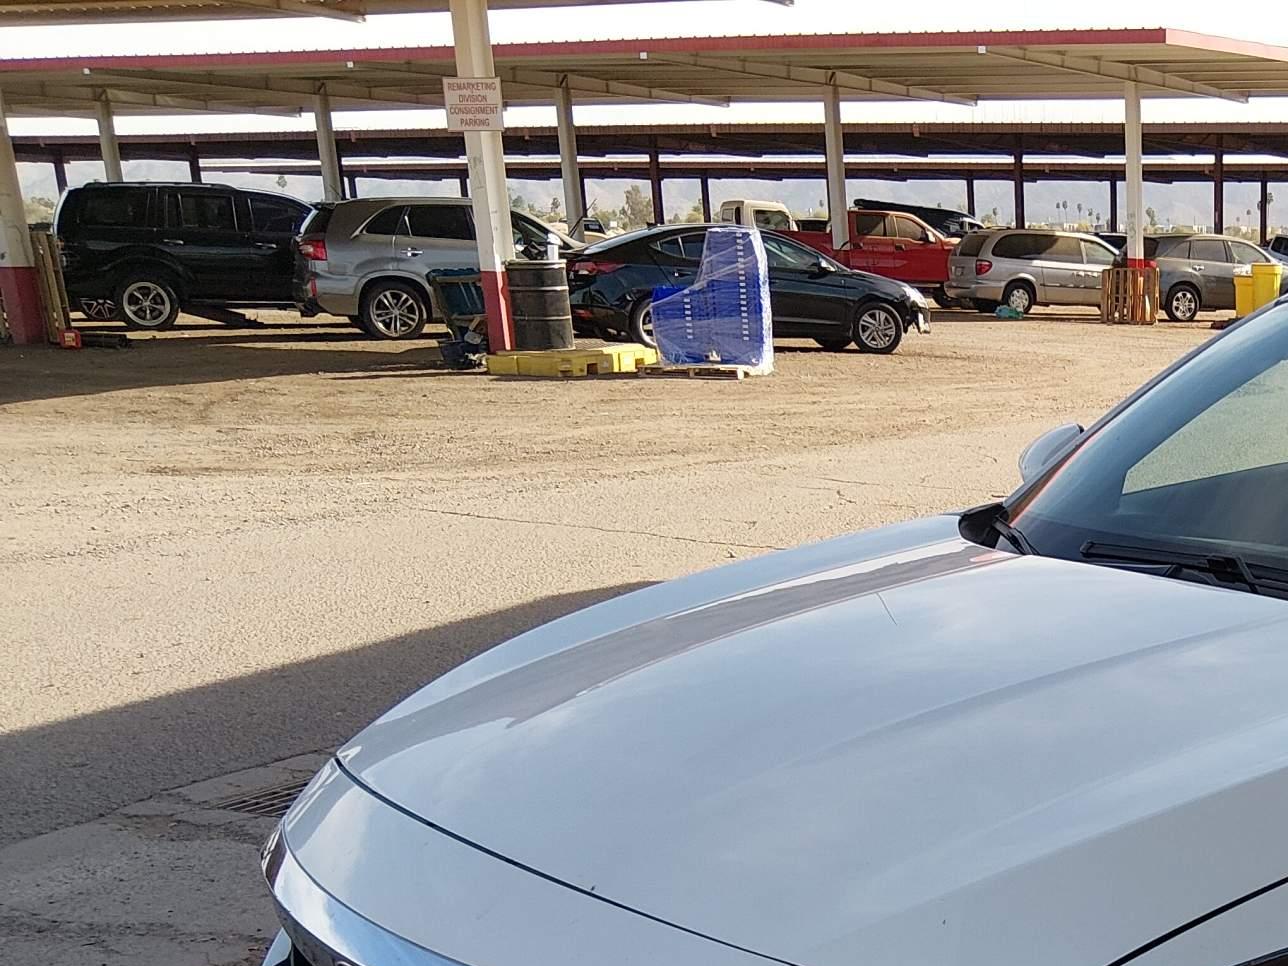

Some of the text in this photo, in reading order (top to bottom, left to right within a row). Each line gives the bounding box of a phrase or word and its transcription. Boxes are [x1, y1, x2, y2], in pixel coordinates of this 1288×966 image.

[448, 83, 496, 91] REMARKETING
[459, 95, 488, 103] DIVISION
[450, 107, 498, 115] CONSIGNMENT
[461, 118, 490, 127] PARKING
